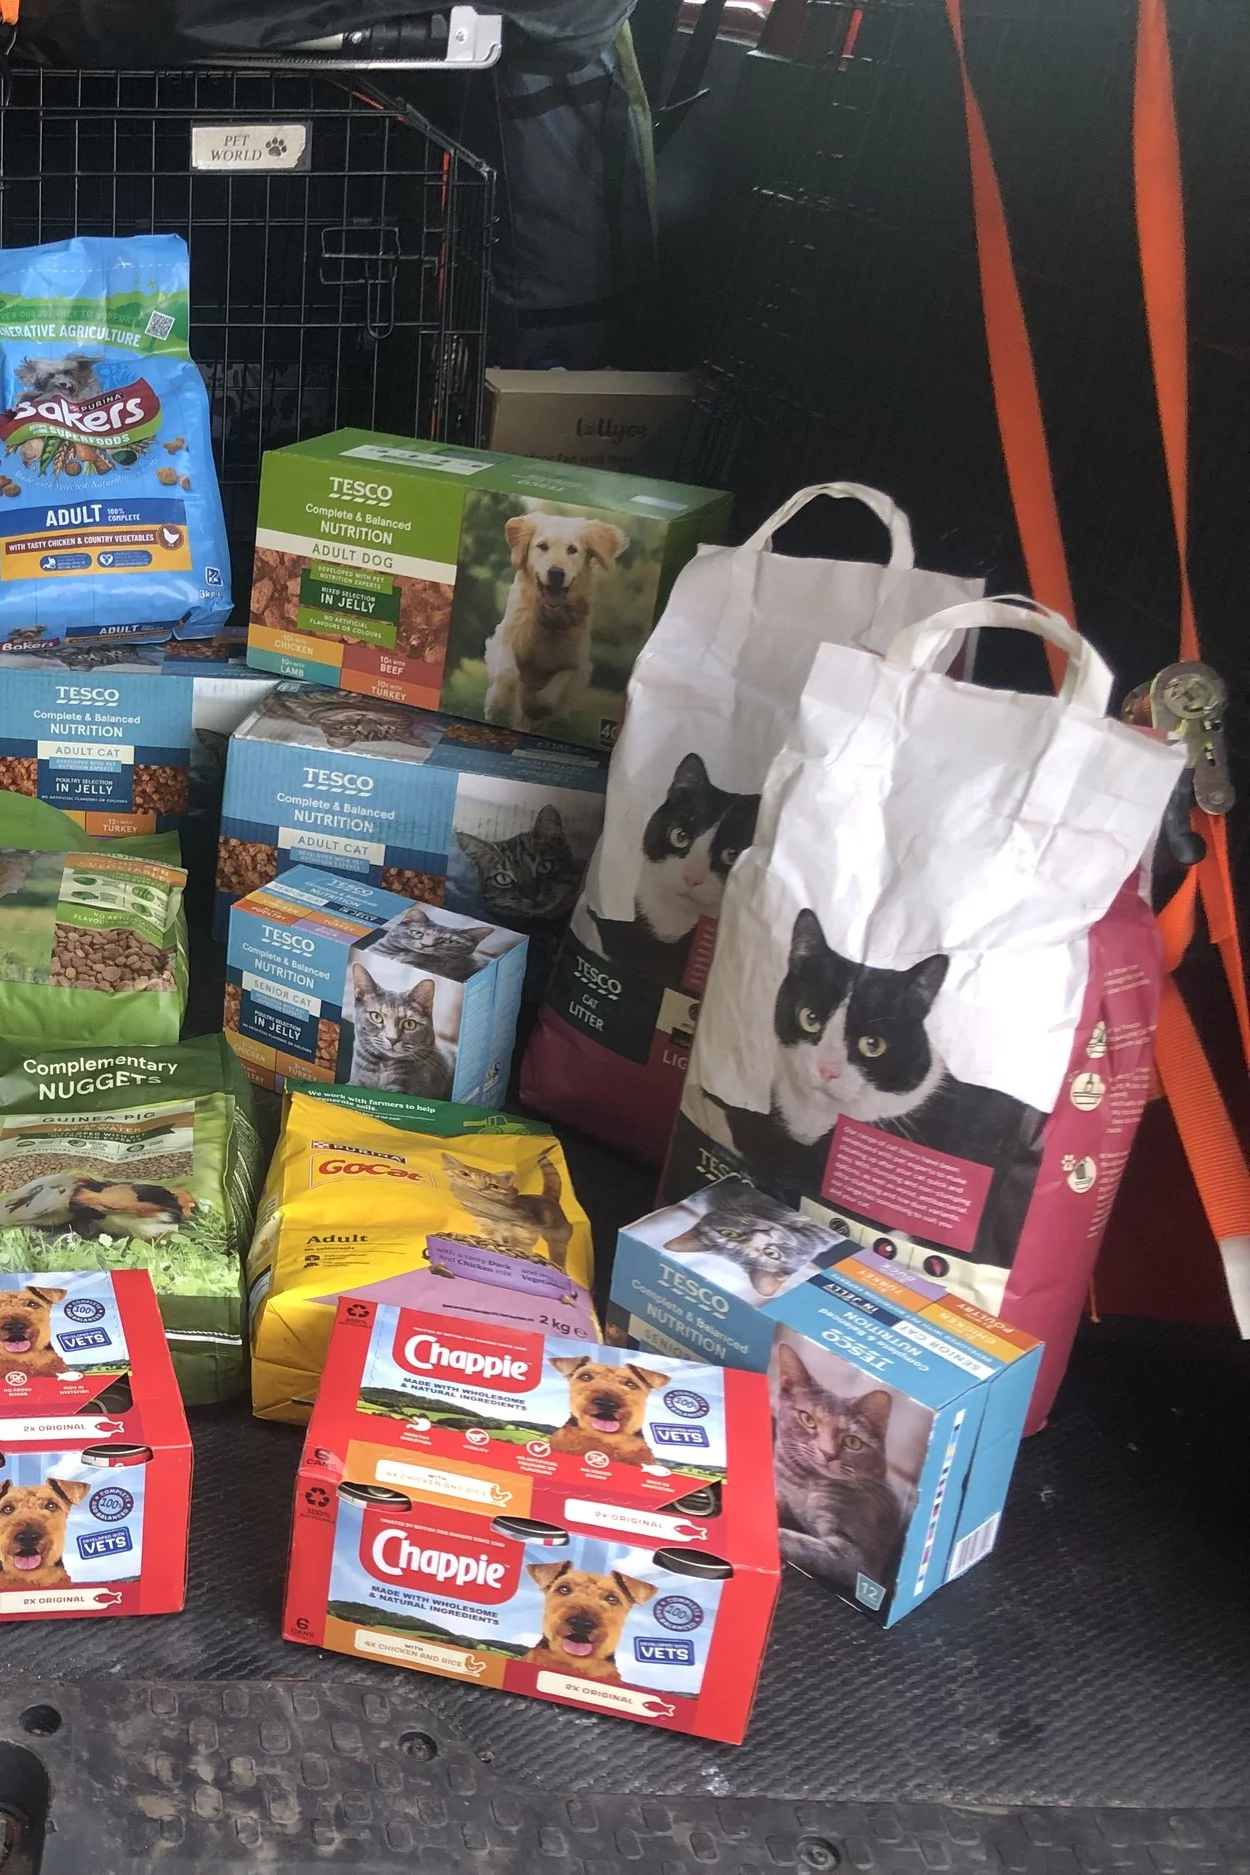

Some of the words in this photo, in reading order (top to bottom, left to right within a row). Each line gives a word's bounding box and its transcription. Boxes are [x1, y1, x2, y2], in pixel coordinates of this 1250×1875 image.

[224, 135, 250, 146] PET
[211, 150, 262, 161] WORLD
[60, 324, 140, 347] AGRICULTURE
[81, 393, 123, 412] PURINA
[49, 426, 130, 445] SUPERFOODS
[329, 476, 393, 501] TESCO
[46, 504, 102, 526] ADULT
[107, 514, 140, 522] COMPLETE
[305, 503, 353, 522] Complete
[356, 512, 362, 522] &
[365, 513, 411, 531] Balanced
[9, 543, 26, 551] WITH
[26, 541, 46, 550] TASTY
[48, 539, 76, 548] CHICKEN
[84, 536, 113, 544] COUNTRY
[114, 534, 154, 542] VEGETABLES
[320, 521, 392, 545] NUTRITION
[312, 543, 357, 561] ADULT
[362, 553, 394, 569] DOG
[321, 594, 333, 605] IN
[338, 596, 375, 614] JELLY
[380, 663, 403, 676] BEEF
[55, 686, 120, 701] TESCO
[371, 686, 407, 701] TURKEY
[33, 710, 82, 722] Complete
[85, 713, 92, 721] &
[94, 713, 140, 725] Balanced
[50, 724, 123, 738] NUTRITION
[56, 746, 92, 757] ADULT
[98, 748, 120, 757] CAT
[56, 783, 69, 793] IN
[75, 783, 113, 795] JELLY
[303, 767, 374, 791] TESCO
[277, 792, 330, 810] Complete
[333, 801, 340, 811] &
[344, 803, 394, 820] Balanced
[102, 825, 138, 834] TURKEY
[294, 810, 374, 833] NUTRITION
[298, 836, 340, 851] ADULT
[344, 843, 369, 856] CAT
[262, 924, 315, 952] TESCO
[255, 959, 314, 989] NUTRITION
[576, 955, 623, 995] TESCO
[254, 979, 289, 1000] SENIOR
[293, 995, 312, 1007] CAT
[582, 994, 599, 1009] CAT
[569, 1001, 604, 1032] LITTER
[254, 1015, 265, 1025] IN
[269, 1021, 300, 1041] JELLY
[23, 1056, 178, 1077] Complementary
[38, 1072, 162, 1101] NUGGETS
[308, 1090, 322, 1098] We
[324, 1091, 345, 1100] work
[347, 1095, 367, 1104] with
[369, 1098, 403, 1110] farmers
[417, 1104, 436, 1114] help
[43, 1115, 115, 1123] GUINEA
[124, 1112, 156, 1121] PIG
[319, 1158, 423, 1182] GoCat
[306, 1234, 368, 1244] Adult
[659, 1262, 730, 1315] TESCO
[539, 1315, 549, 1325] 2
[549, 1318, 571, 1335] kg
[647, 1305, 726, 1359] NUTRITION
[65, 1333, 105, 1348] VETS
[403, 1334, 528, 1382] Chappie
[658, 1429, 704, 1444] VETS
[84, 1536, 127, 1554] VETS
[372, 1528, 503, 1590] Chappie
[23, 1597, 36, 1605] 2X
[38, 1595, 86, 1605] ORIGINAL
[860, 1582, 878, 1600] 12
[639, 1645, 689, 1661] VETS
